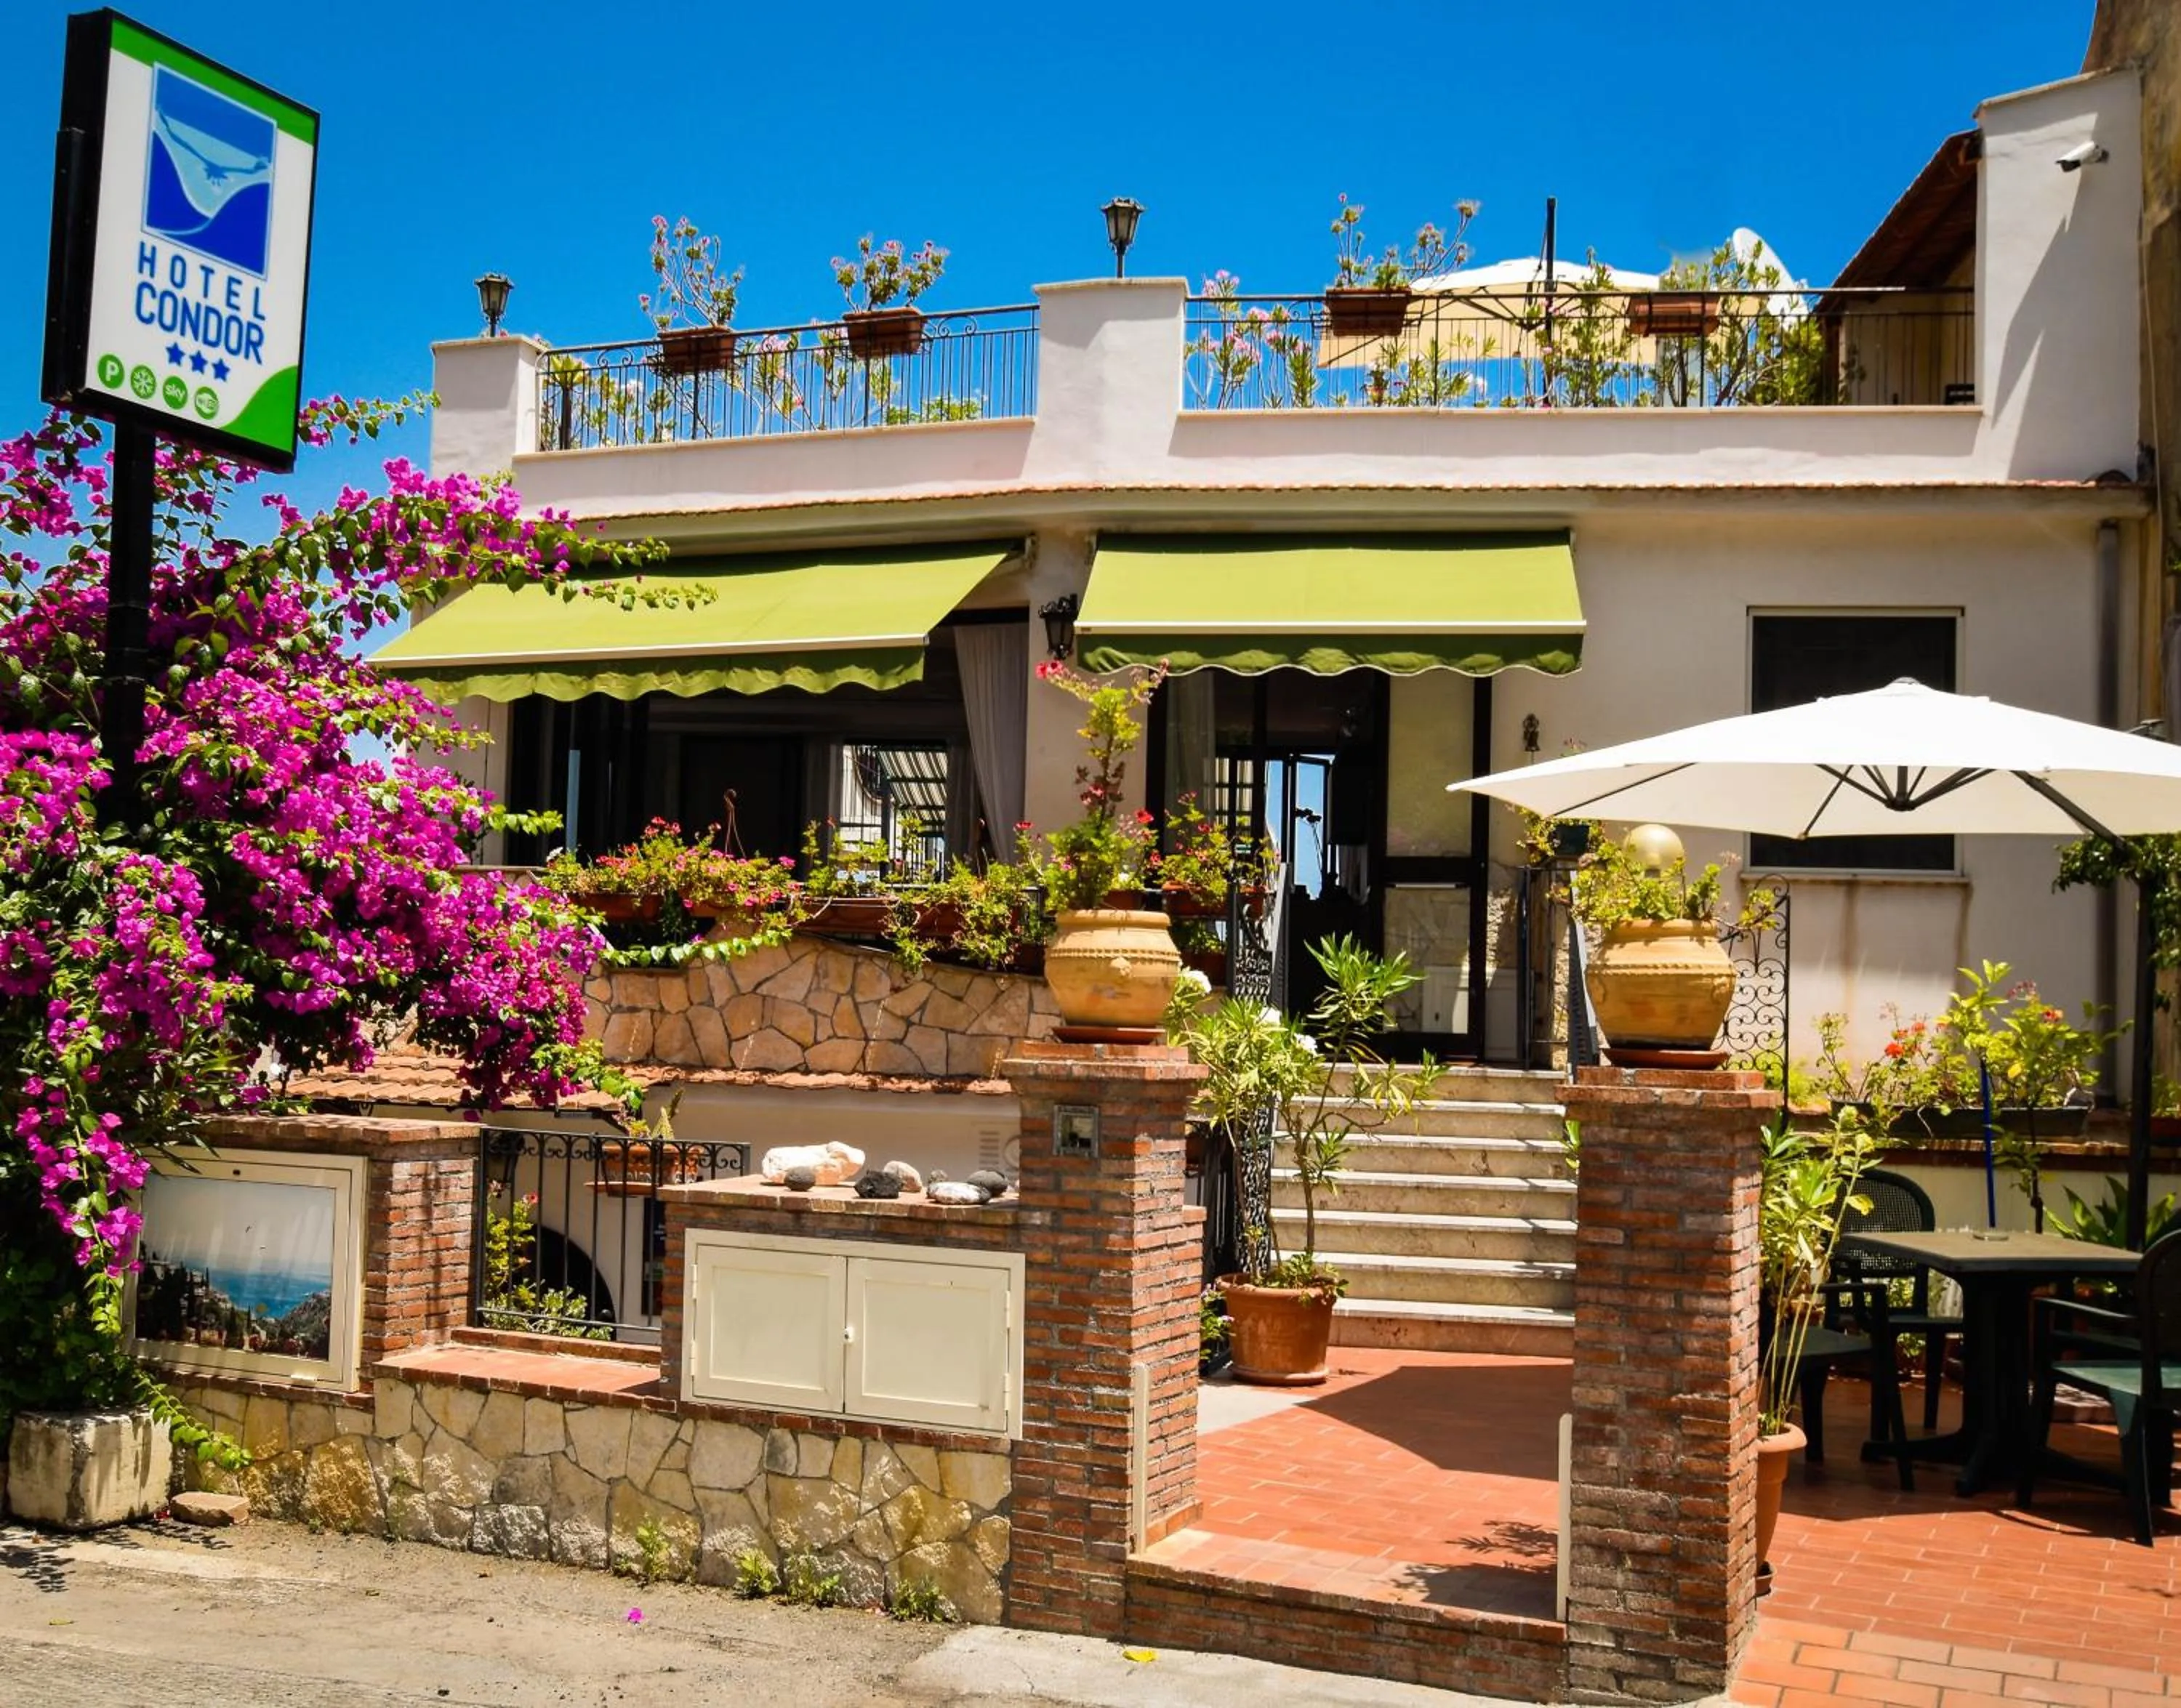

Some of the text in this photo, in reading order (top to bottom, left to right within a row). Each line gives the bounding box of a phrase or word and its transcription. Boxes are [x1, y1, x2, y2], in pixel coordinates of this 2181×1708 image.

[138, 242, 265, 321] HOTEL
[136, 282, 263, 364] CONDOR
[105, 360, 119, 382] P
[165, 384, 185, 401] sky
